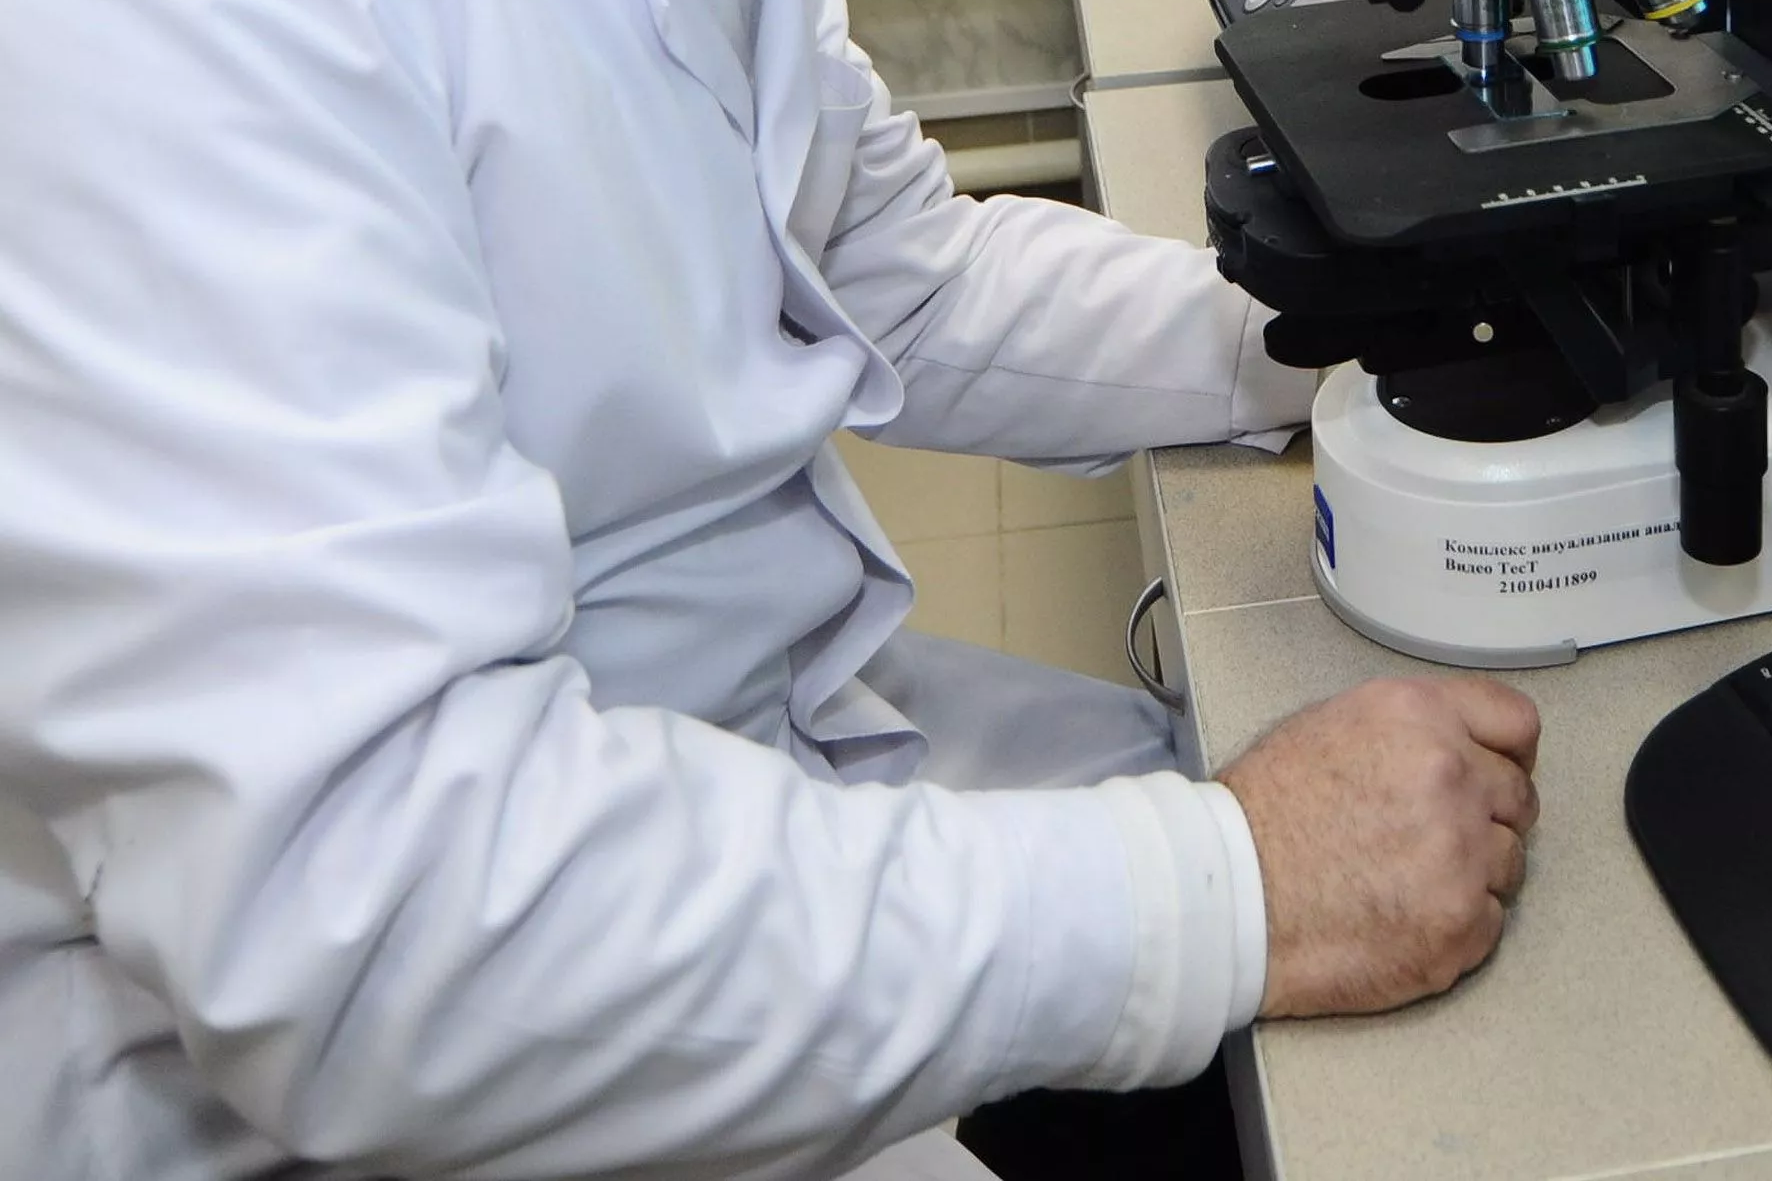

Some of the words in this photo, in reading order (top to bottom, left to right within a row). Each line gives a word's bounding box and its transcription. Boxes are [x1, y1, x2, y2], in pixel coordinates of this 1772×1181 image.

[1445, 538, 1527, 557] Комплекс
[1531, 527, 1641, 555] визуализации
[1445, 557, 1494, 575] Видео
[1498, 560, 1540, 575] ТесТ
[1499, 569, 1599, 595] 21010411899
